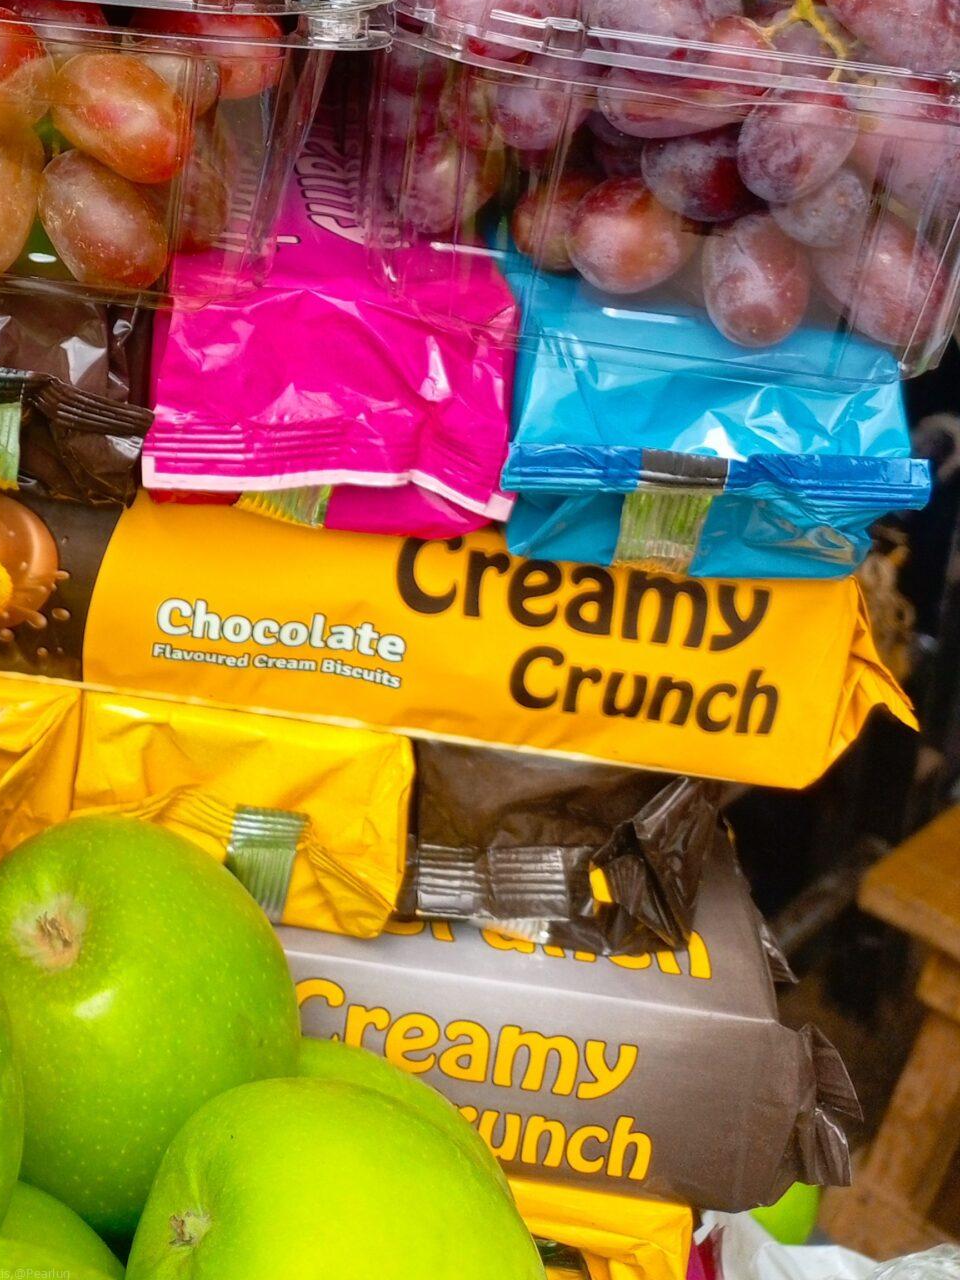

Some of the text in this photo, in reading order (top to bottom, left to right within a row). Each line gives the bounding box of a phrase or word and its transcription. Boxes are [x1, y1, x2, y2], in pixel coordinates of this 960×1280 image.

[156, 596, 408, 663] Chocolate
[396, 535, 771, 651] Creamy
[151, 642, 402, 689] Flavoured Cream Biscuits
[509, 646, 779, 736] Crunch
